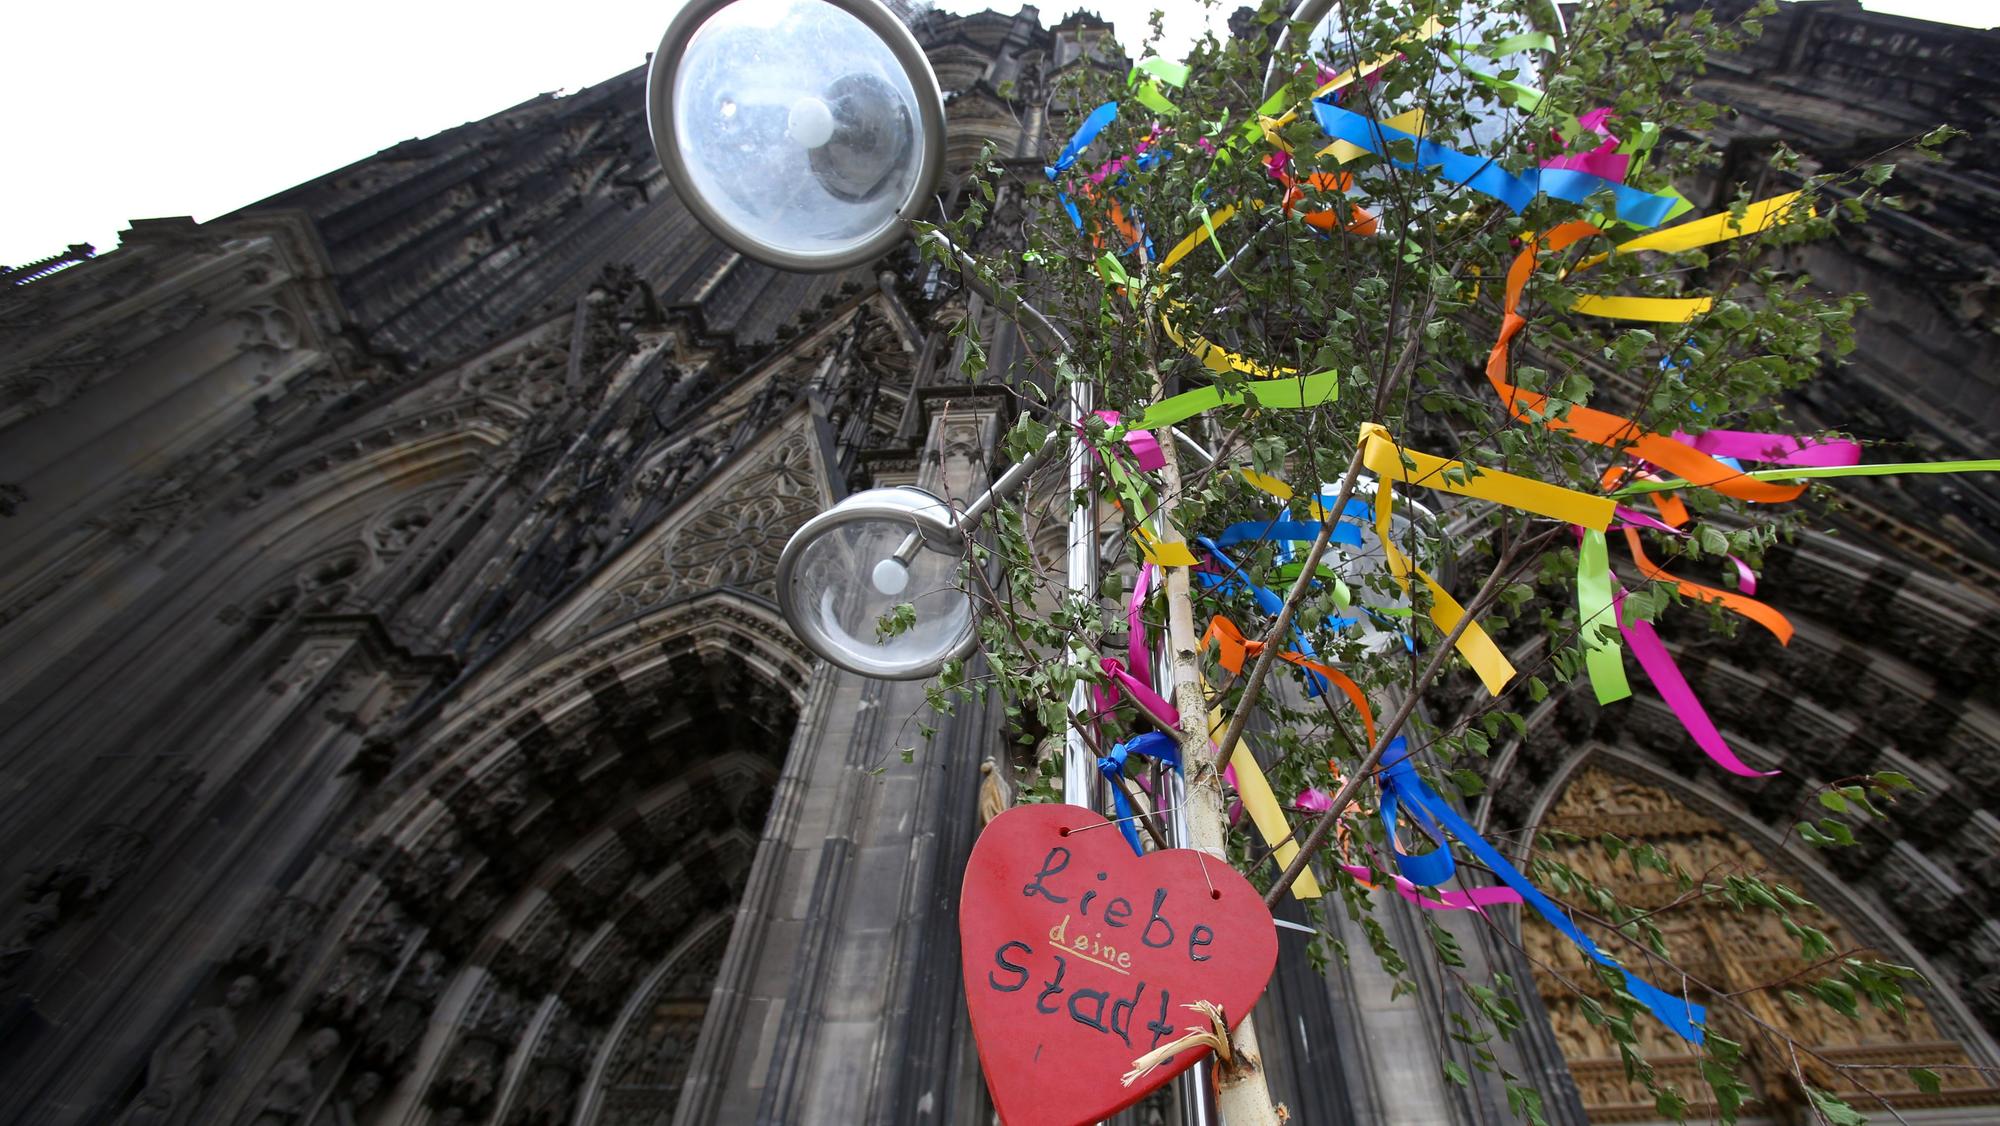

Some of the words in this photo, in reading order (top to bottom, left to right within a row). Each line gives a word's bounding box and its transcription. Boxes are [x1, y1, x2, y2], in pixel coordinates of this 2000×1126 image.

[1023, 847, 1214, 961] Liebe
[1049, 914, 1132, 969] deine
[988, 940, 1174, 1065] Stadt
